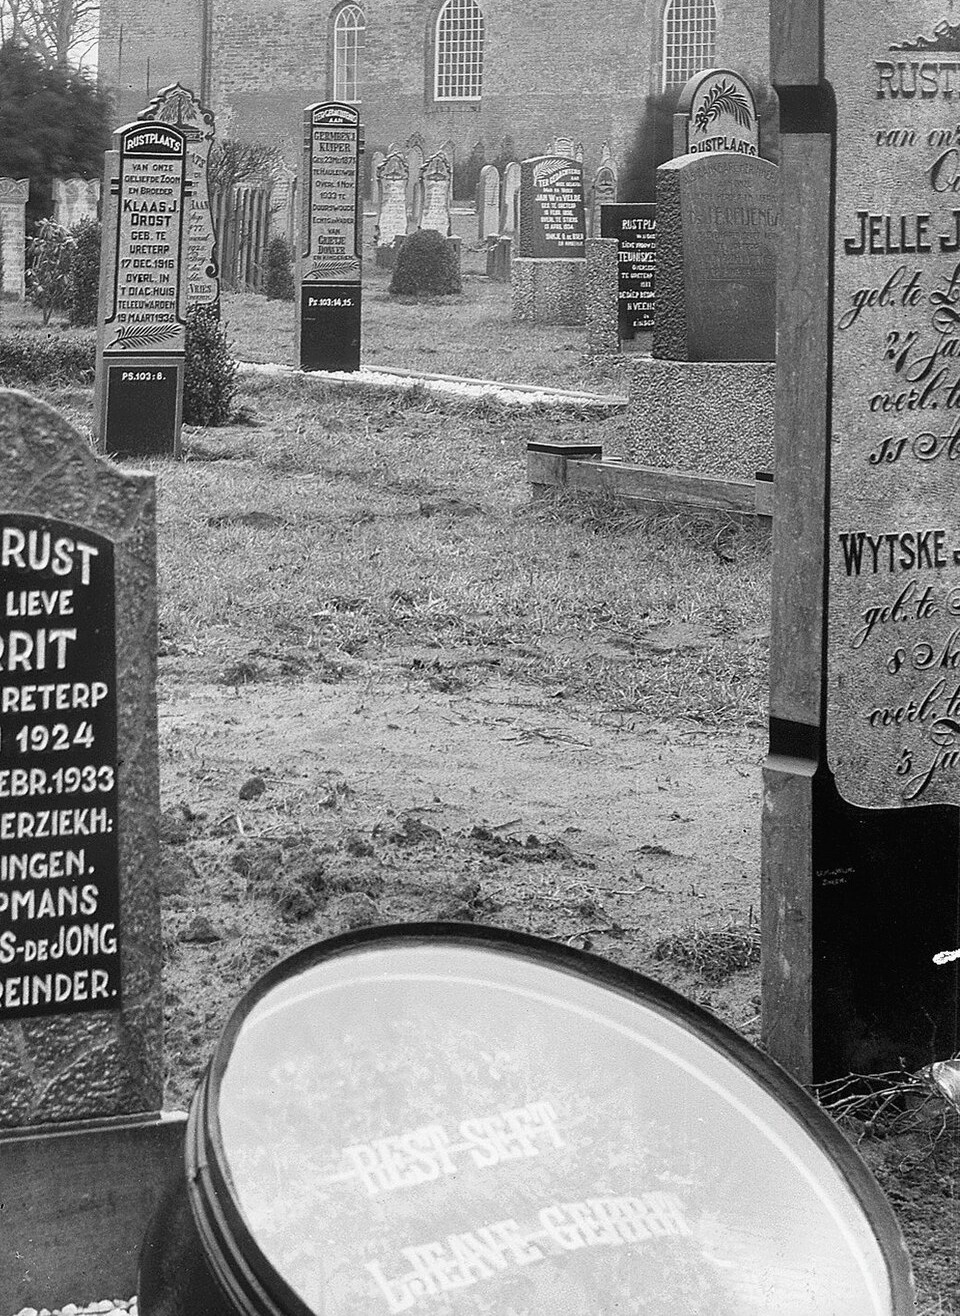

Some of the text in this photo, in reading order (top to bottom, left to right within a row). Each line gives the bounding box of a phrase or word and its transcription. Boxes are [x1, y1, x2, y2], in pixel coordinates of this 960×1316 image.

[126, 133, 181, 152] RUSTPLAATS
[152, 164, 174, 172] ONZE
[140, 187, 174, 195] BROEDER
[123, 199, 180, 213] KLAAS J.
[131, 213, 172, 227] DROST
[131, 231, 167, 241] GEB. TE
[844, 210, 931, 255] JELLE
[129, 245, 170, 255] URETERP
[120, 259, 132, 269] 17
[159, 273, 170, 283] IN
[1, 528, 99, 585] RUST
[840, 530, 946, 576] WYTSKE
[6, 590, 74, 616] LIEVE
[16, 721, 95, 753] 1924
